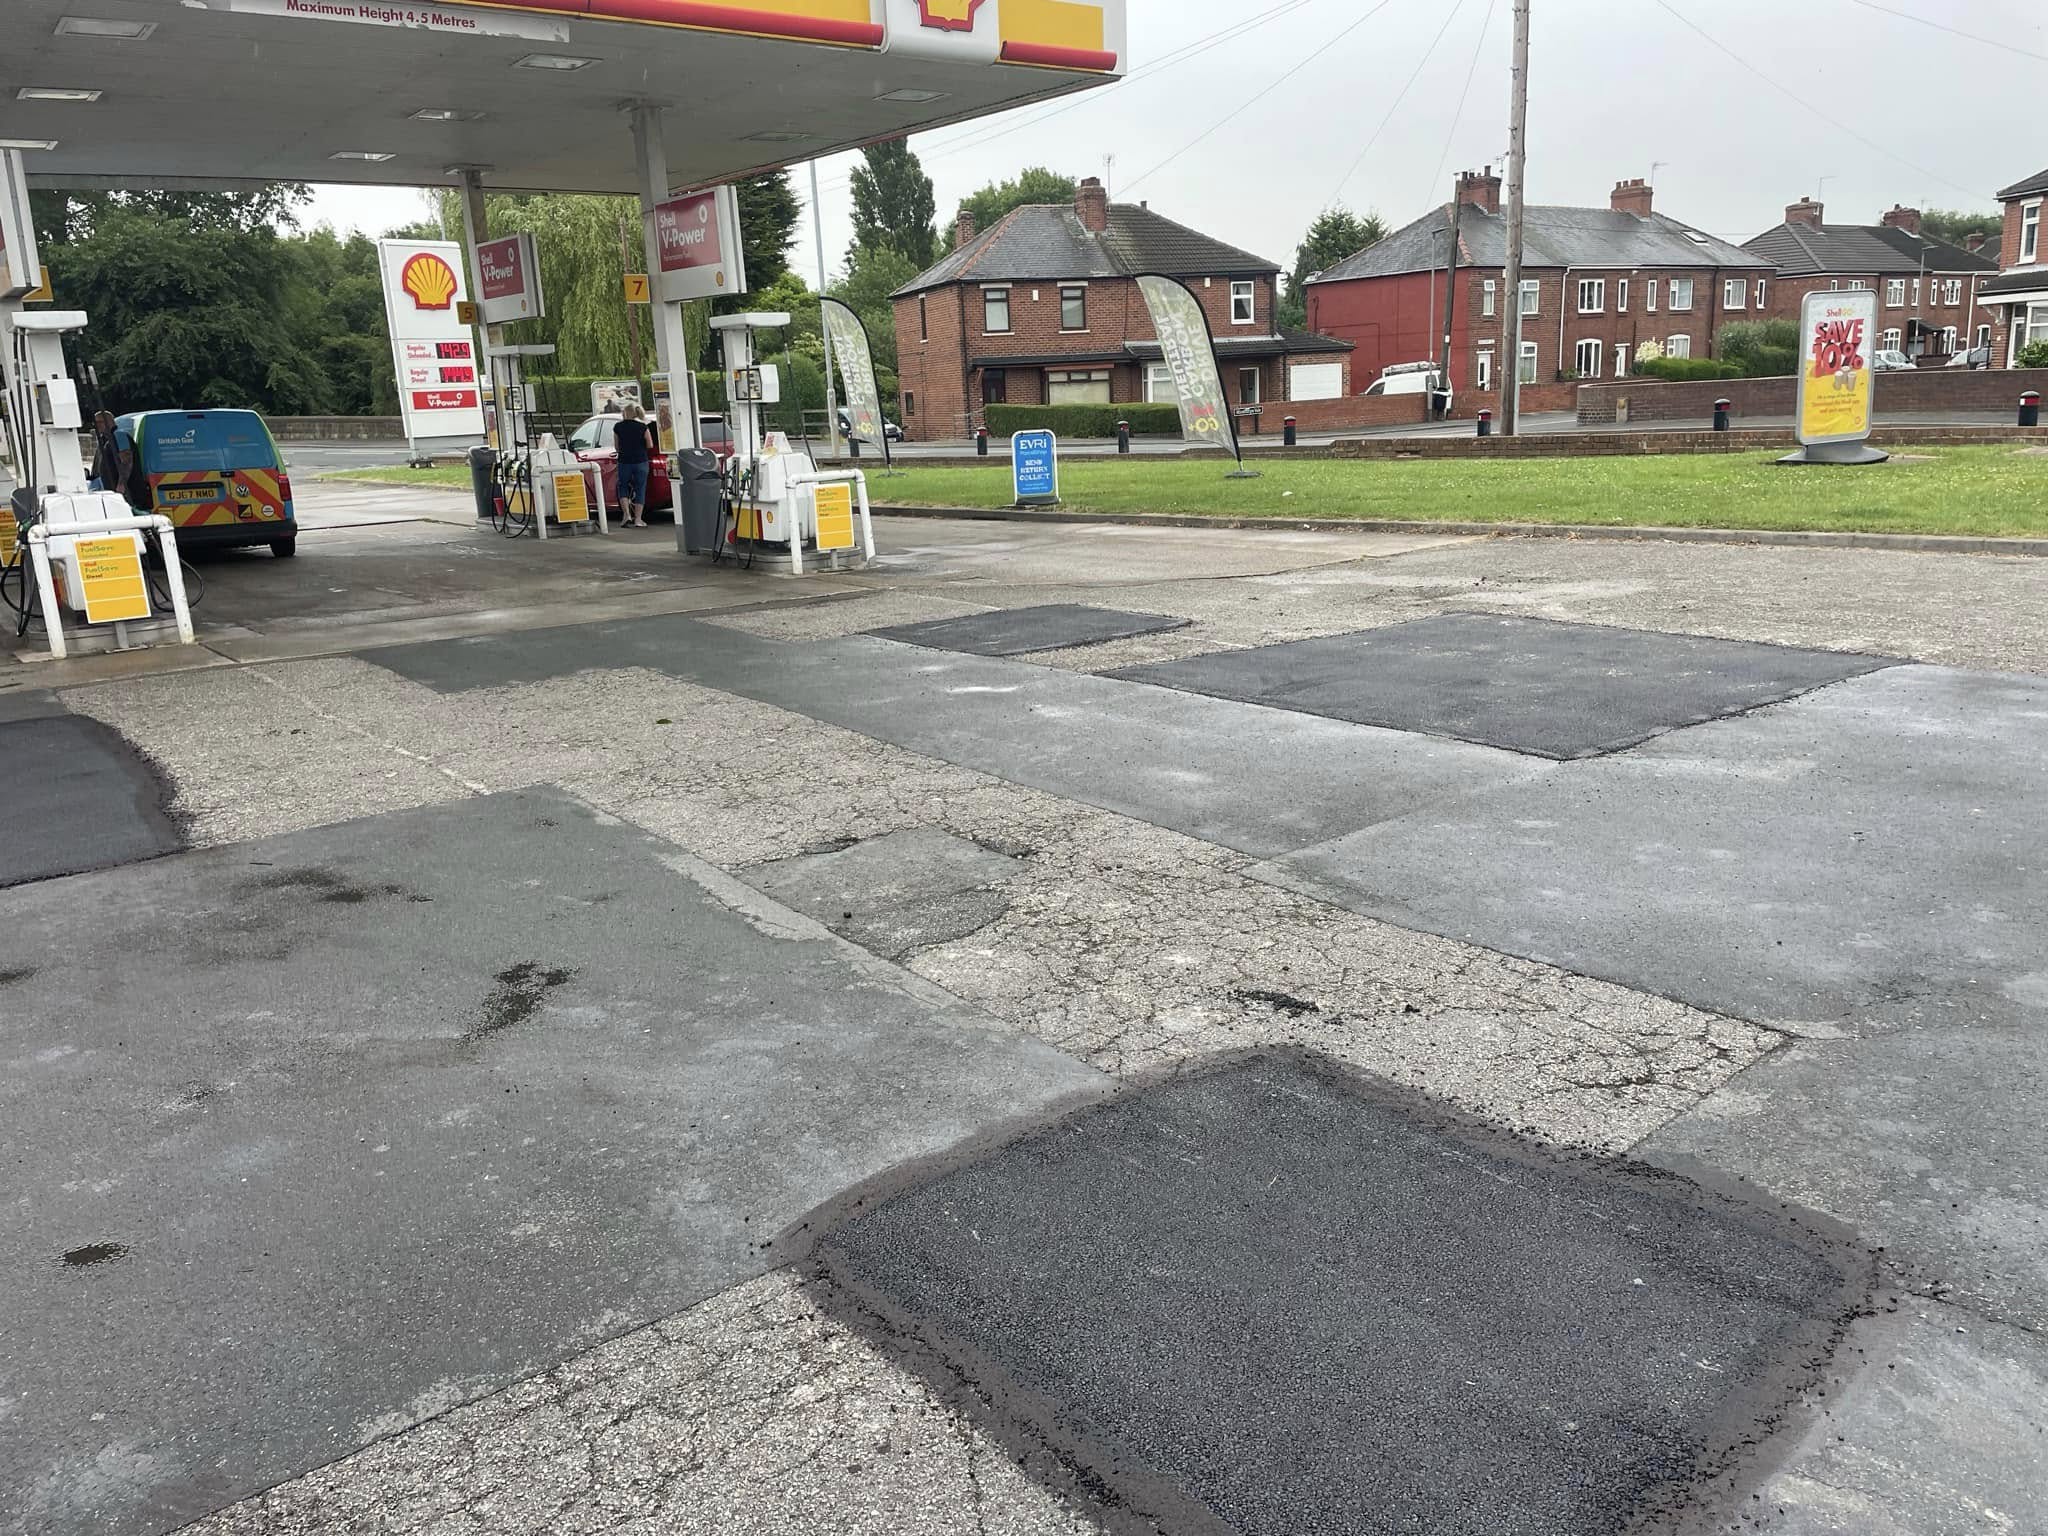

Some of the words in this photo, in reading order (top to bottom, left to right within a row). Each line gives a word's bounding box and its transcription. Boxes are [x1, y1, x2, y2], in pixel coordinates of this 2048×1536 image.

[286, 0, 355, 17] Maximum
[359, 6, 404, 23] Height
[406, 11, 428, 24] 4.5
[431, 13, 476, 28] Metres
[660, 211, 676, 229] Shell
[661, 226, 706, 249] V-Power
[480, 252, 493, 266] Shell
[482, 265, 514, 281] V-Power
[632, 280, 643, 295] 7
[464, 307, 473, 319] 5
[1814, 318, 1865, 344] SAVE
[1812, 342, 1864, 377] 10%
[428, 399, 461, 407] V-Power
[158, 437, 180, 445] British
[181, 436, 195, 444] Gas
[1019, 473, 1050, 481] COLLECT
